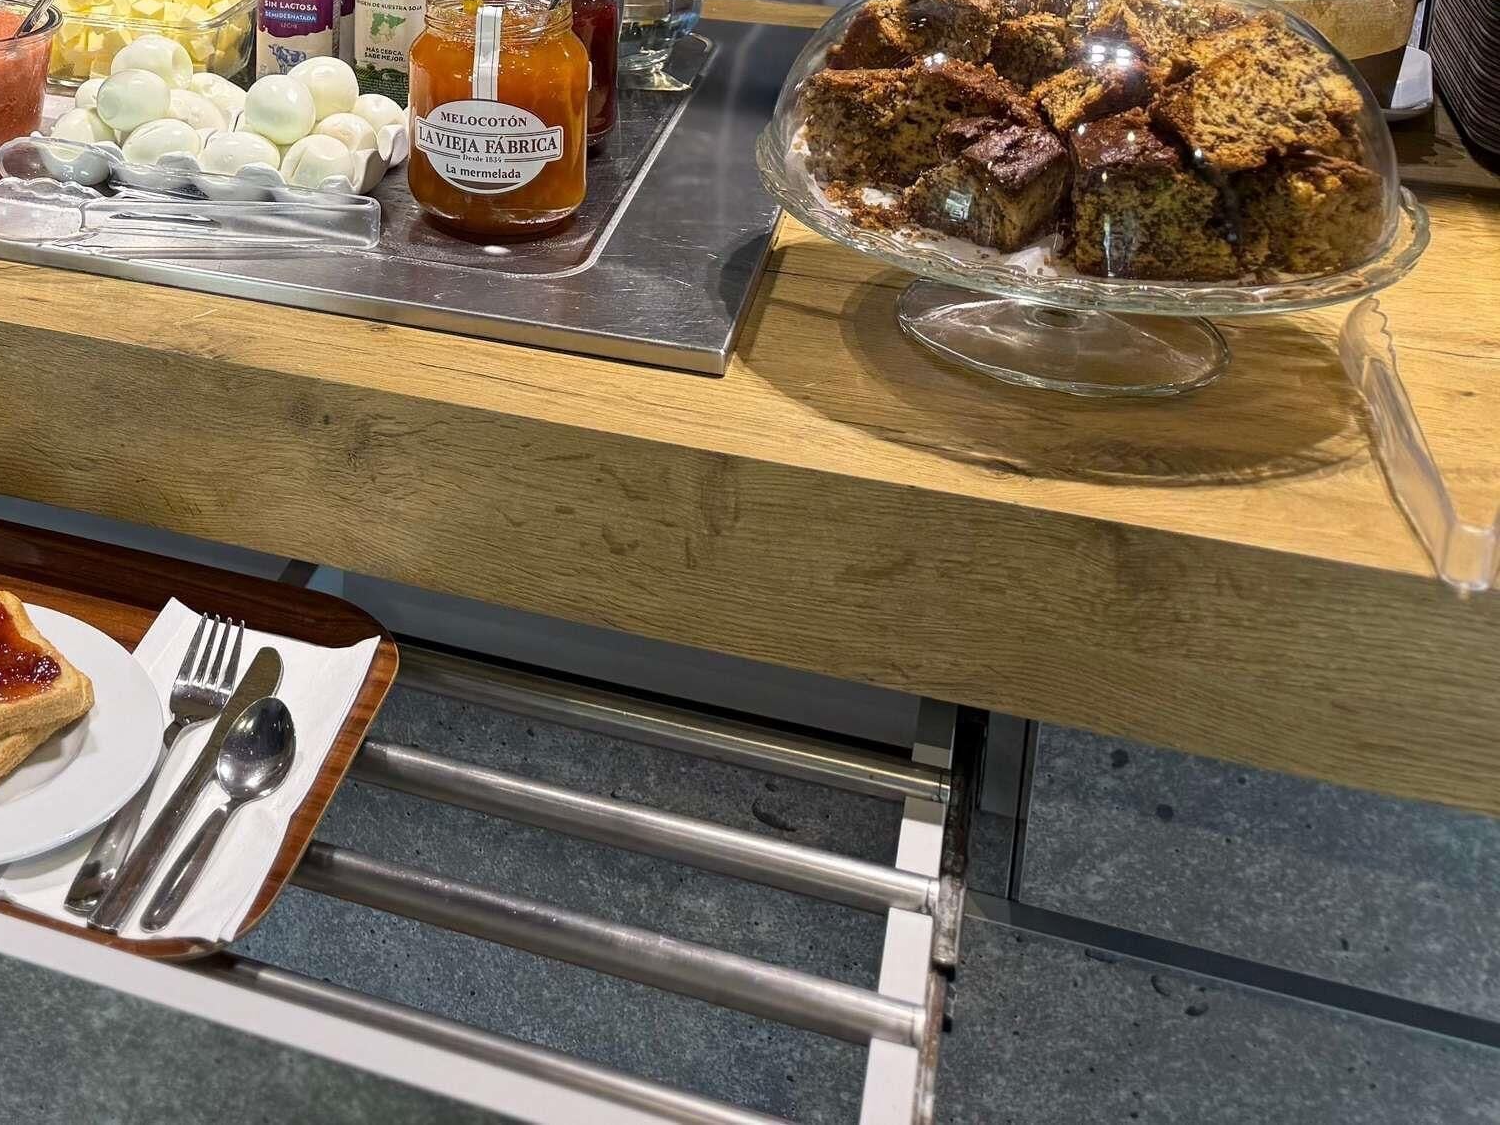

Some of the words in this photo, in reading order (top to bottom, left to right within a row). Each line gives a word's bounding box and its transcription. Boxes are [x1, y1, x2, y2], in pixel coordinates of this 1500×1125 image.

[264, 0, 277, 8] SIN
[280, 2, 317, 11] LACTOSA
[264, 11, 316, 21] SEMIDESNATADA
[441, 111, 527, 127] MELOCOTÓN
[419, 126, 435, 144] LA
[435, 132, 479, 153] VIEJA
[485, 136, 558, 154] FÁBRICA
[446, 163, 456, 174] La
[460, 165, 521, 179] mermelada
